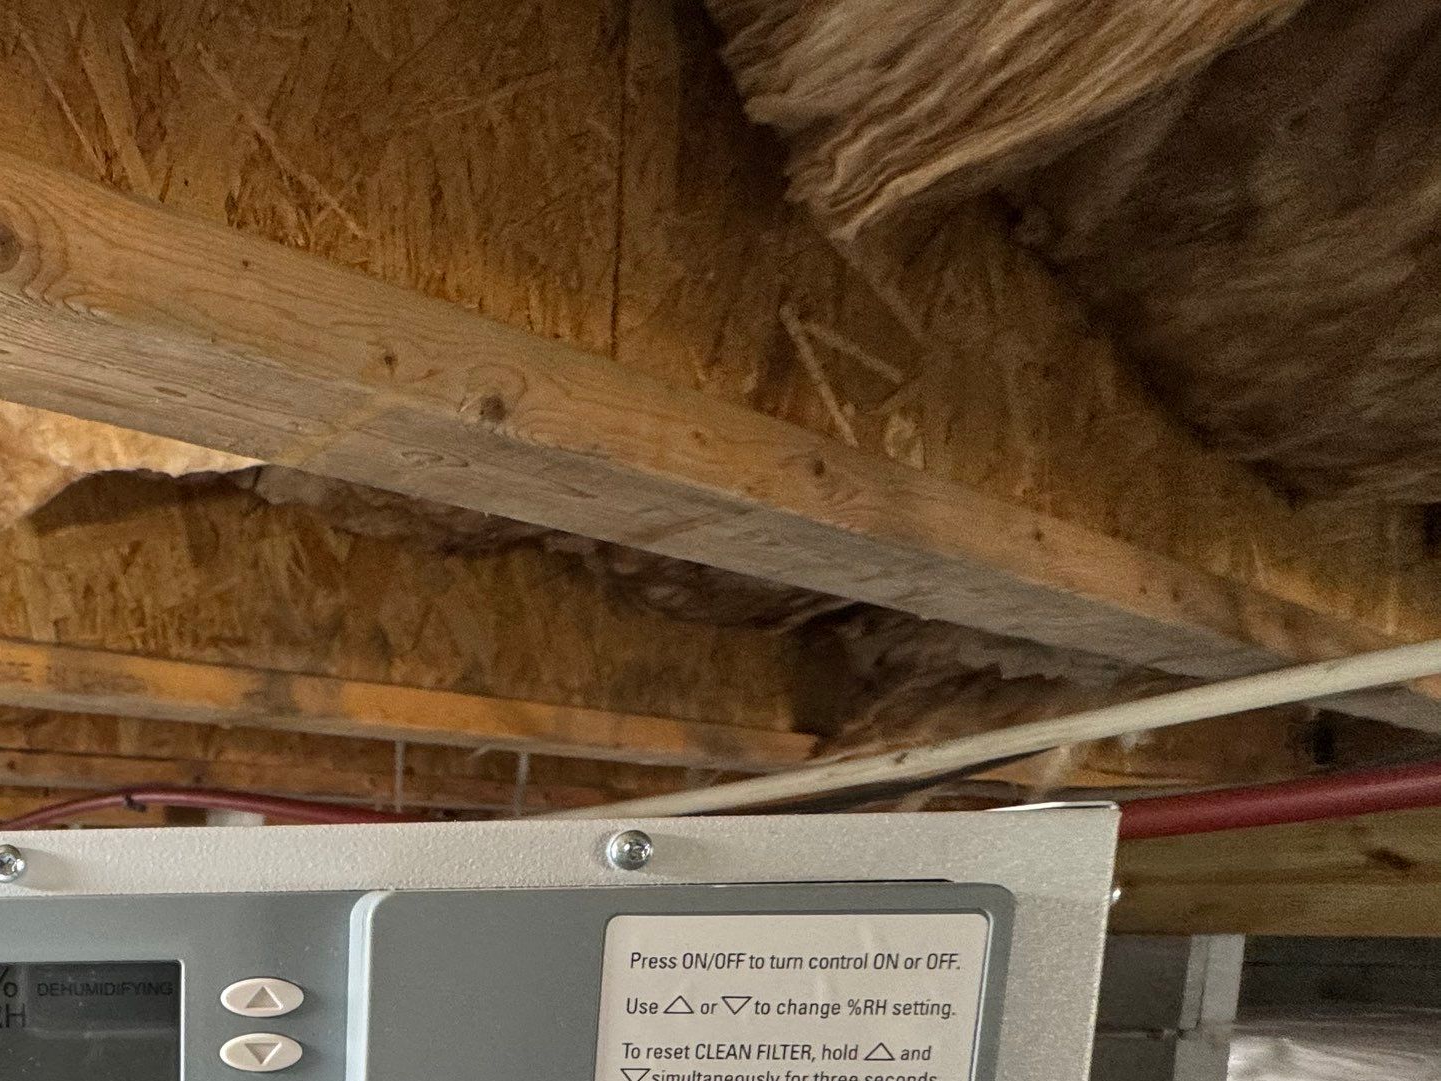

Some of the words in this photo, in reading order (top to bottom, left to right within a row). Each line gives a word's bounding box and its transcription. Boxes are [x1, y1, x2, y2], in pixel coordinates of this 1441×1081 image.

[630, 952, 678, 970] Press
[682, 952, 746, 972] ON/OFF
[749, 954, 765, 970] to
[770, 954, 803, 970] turn
[809, 953, 868, 970] control
[873, 953, 900, 970] ON
[904, 957, 923, 970] or
[927, 953, 961, 970] OFF.
[36, 980, 175, 998] DEHUMIDIFYING
[626, 998, 659, 1015] Use
[700, 1003, 718, 1015] or
[754, 1000, 771, 1015] to
[776, 998, 841, 1019] change
[847, 999, 888, 1016] %RH
[892, 999, 957, 1020] setting.
[622, 1043, 641, 1060] To
[645, 1045, 690, 1060] reset
[695, 1044, 752, 1060] CLEAN
[757, 1044, 816, 1063] FILTER,
[821, 1044, 859, 1061] hold
[900, 1046, 932, 1061] and
